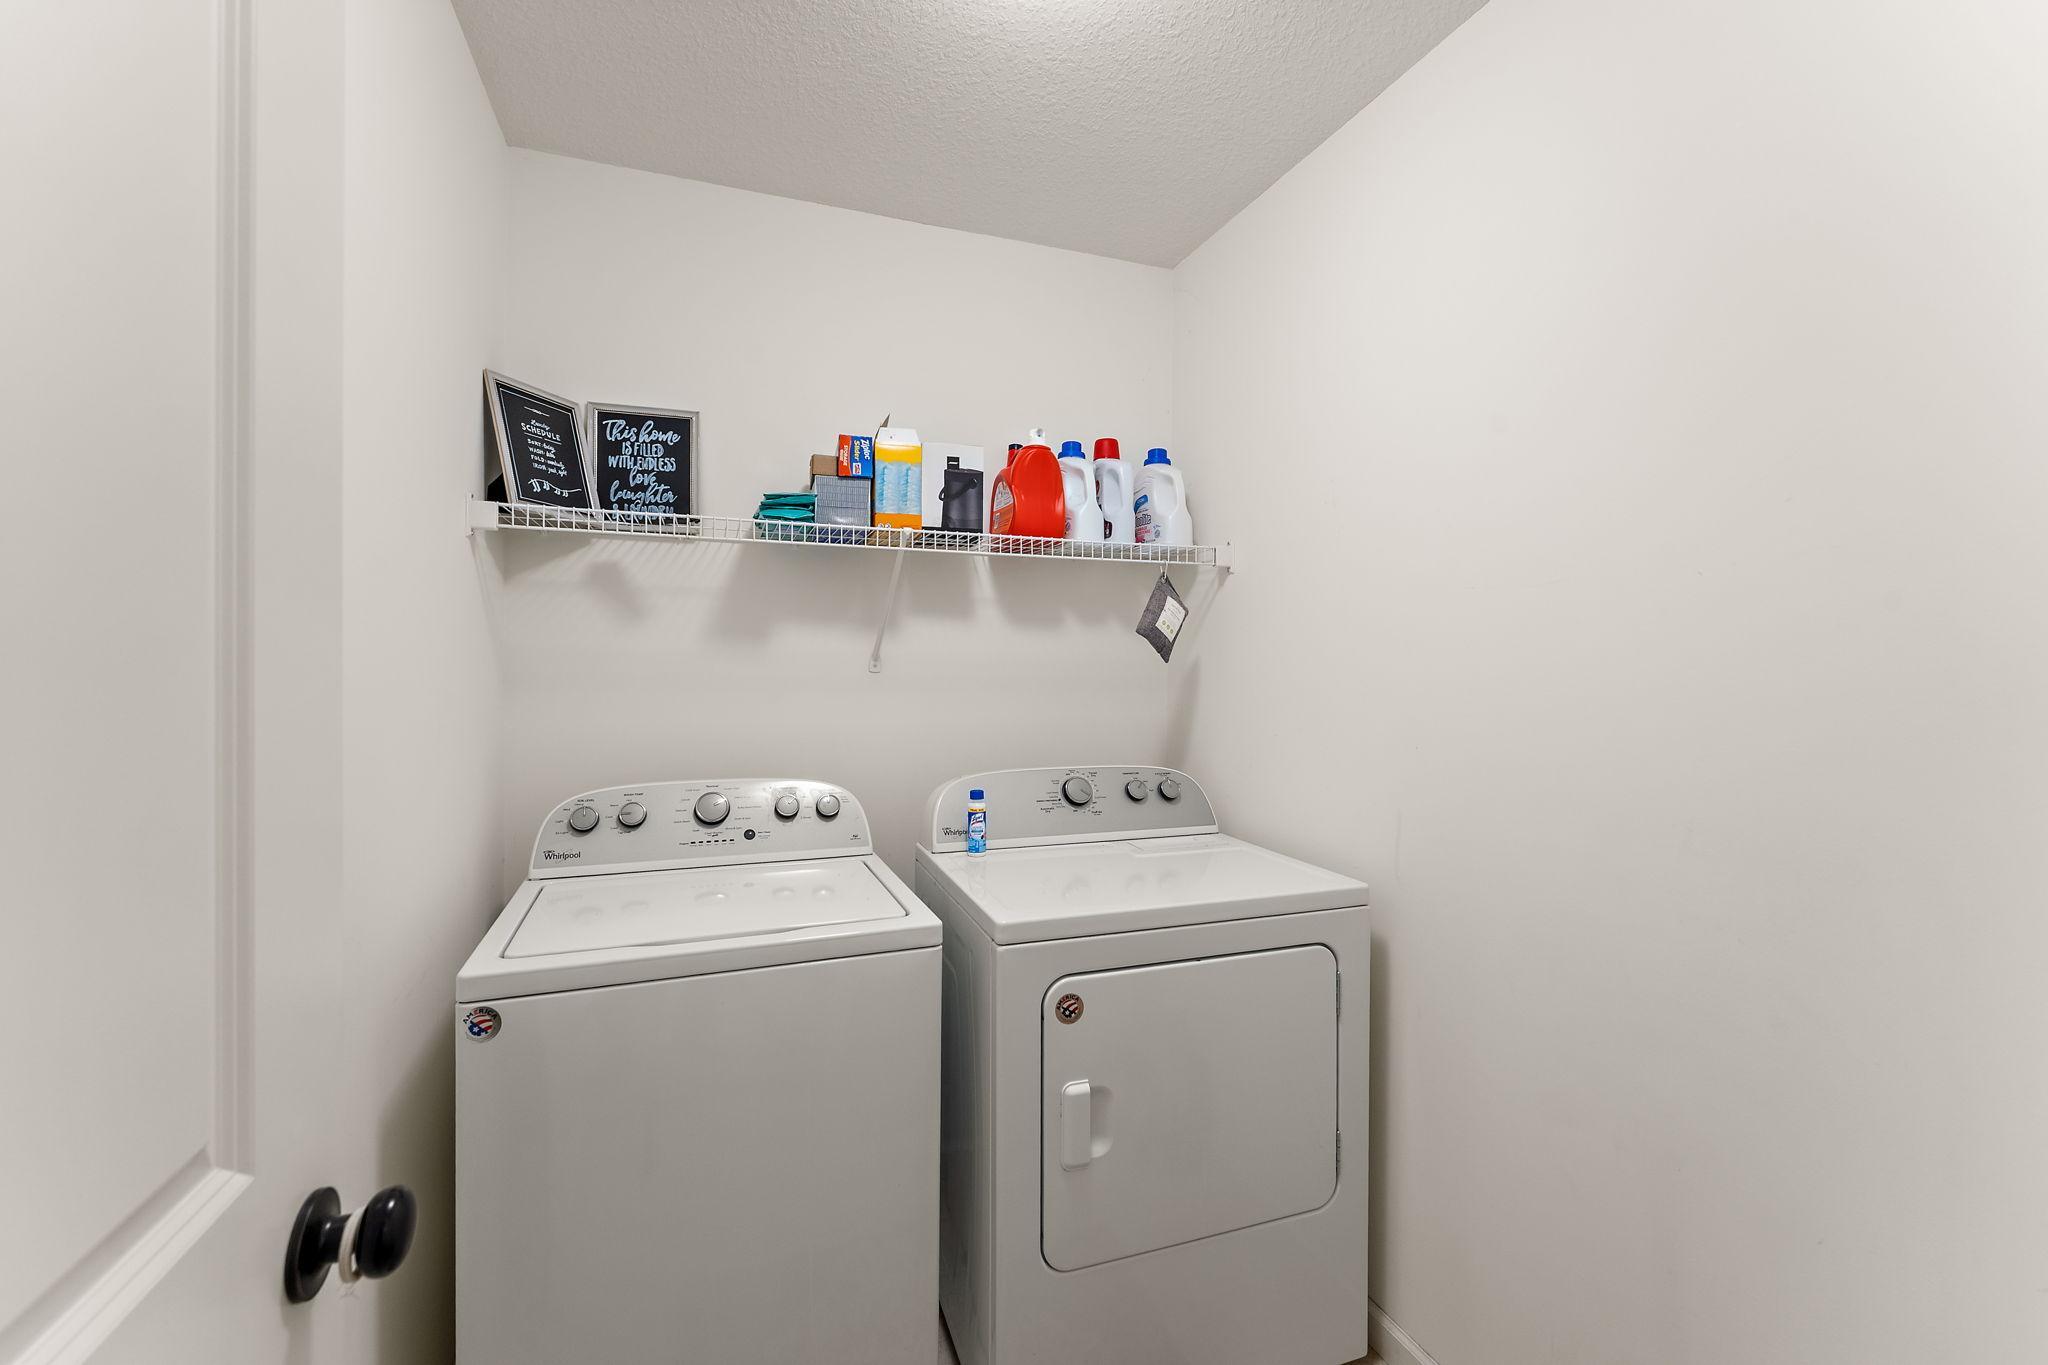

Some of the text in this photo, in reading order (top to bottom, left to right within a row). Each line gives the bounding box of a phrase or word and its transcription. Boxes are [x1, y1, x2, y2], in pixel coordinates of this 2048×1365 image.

[520, 422, 561, 441] SCHEDULE
[602, 419, 680, 445] This home
[622, 440, 665, 457] IS FILLED
[853, 440, 861, 461] Slider
[860, 439, 871, 460] Ziploc
[608, 455, 676, 472] WITH ENDLESS
[629, 466, 657, 487] love
[609, 479, 677, 508] laughter
[942, 829, 968, 837] Whirlpo
[544, 851, 581, 860] Whirlpool
[462, 1008, 498, 1024] AMERICA
